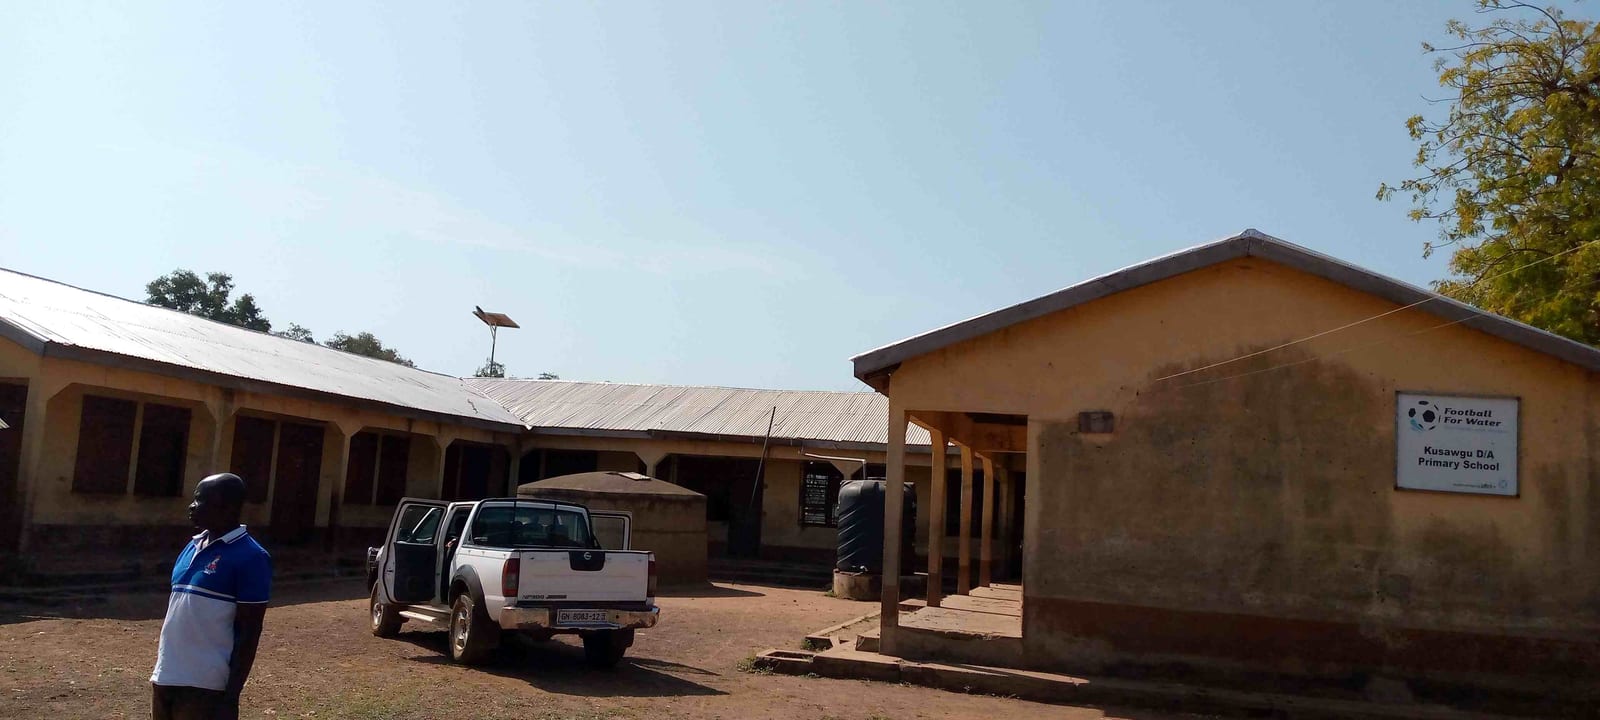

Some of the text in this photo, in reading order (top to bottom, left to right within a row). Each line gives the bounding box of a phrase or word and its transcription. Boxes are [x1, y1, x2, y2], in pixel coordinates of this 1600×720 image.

[1444, 407, 1492, 417] Football
[1466, 418, 1502, 427] Water
[1424, 446, 1494, 459] Kusawgu D/A
[1418, 457, 1499, 471] Primary School
